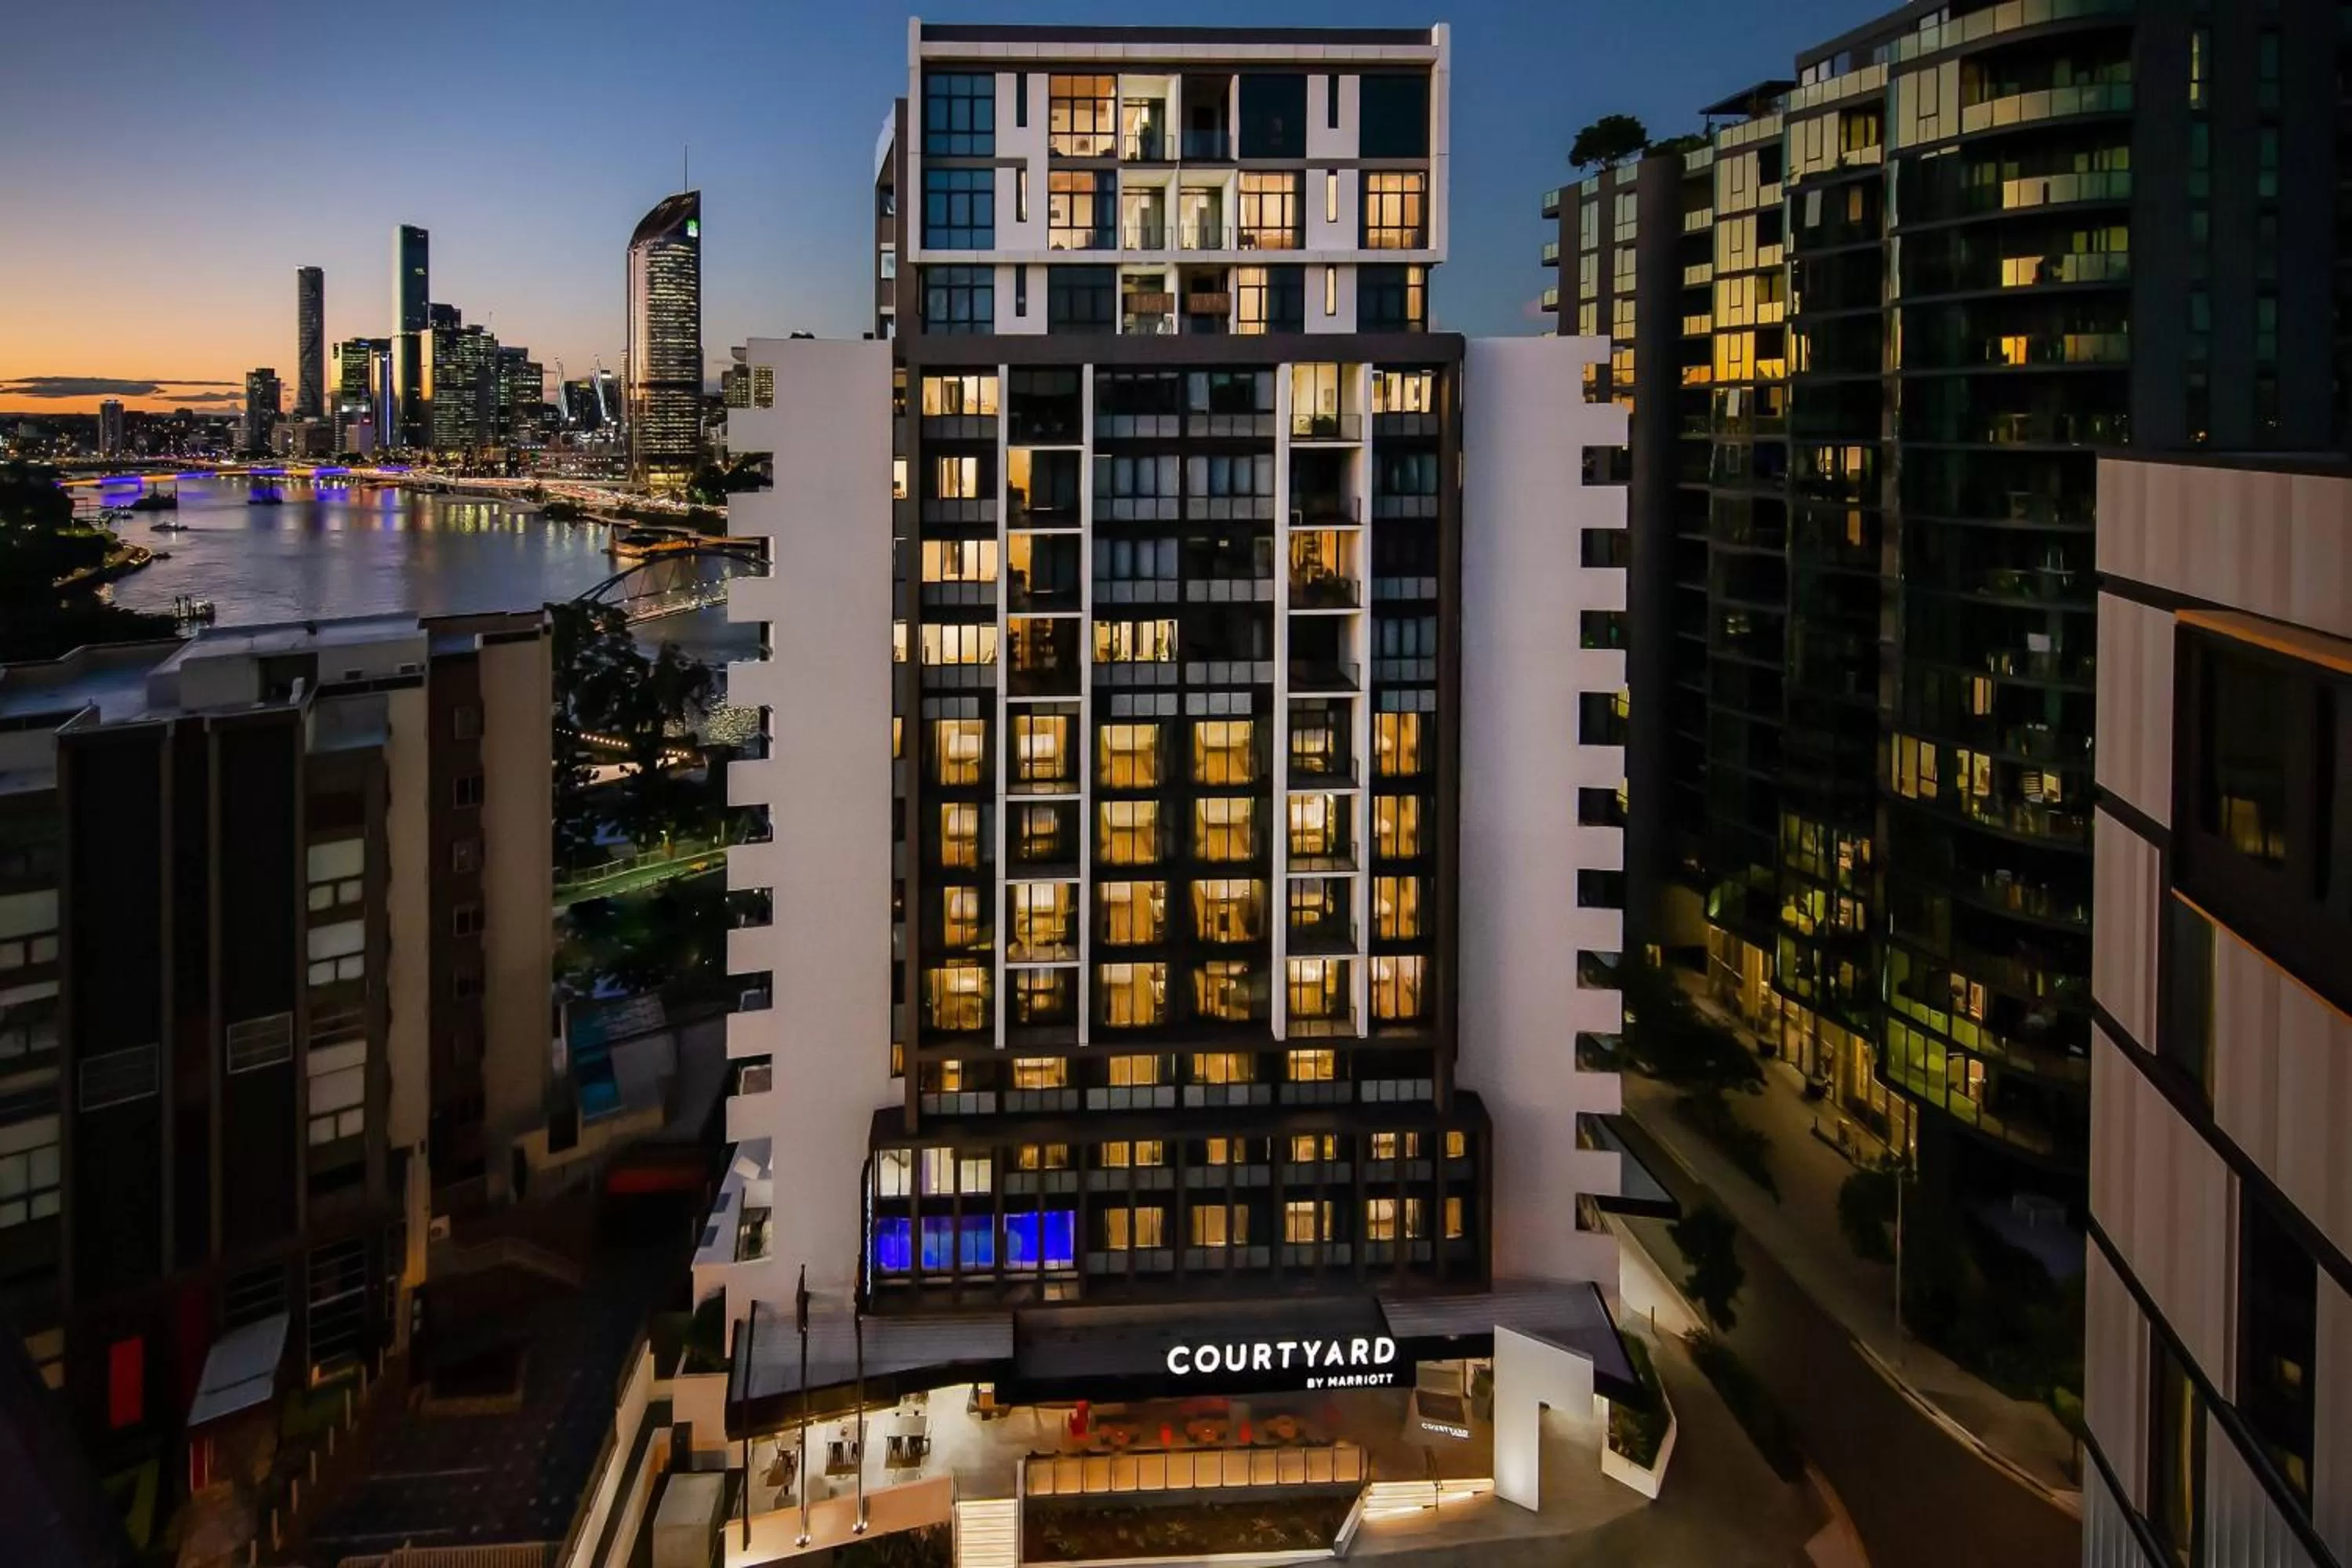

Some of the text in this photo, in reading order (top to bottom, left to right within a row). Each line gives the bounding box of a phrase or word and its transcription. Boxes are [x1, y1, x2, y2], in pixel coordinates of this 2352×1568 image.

[1167, 1337, 1396, 1374] COURTYARD
[1307, 1373, 1393, 1388] BY MARRIOTT
